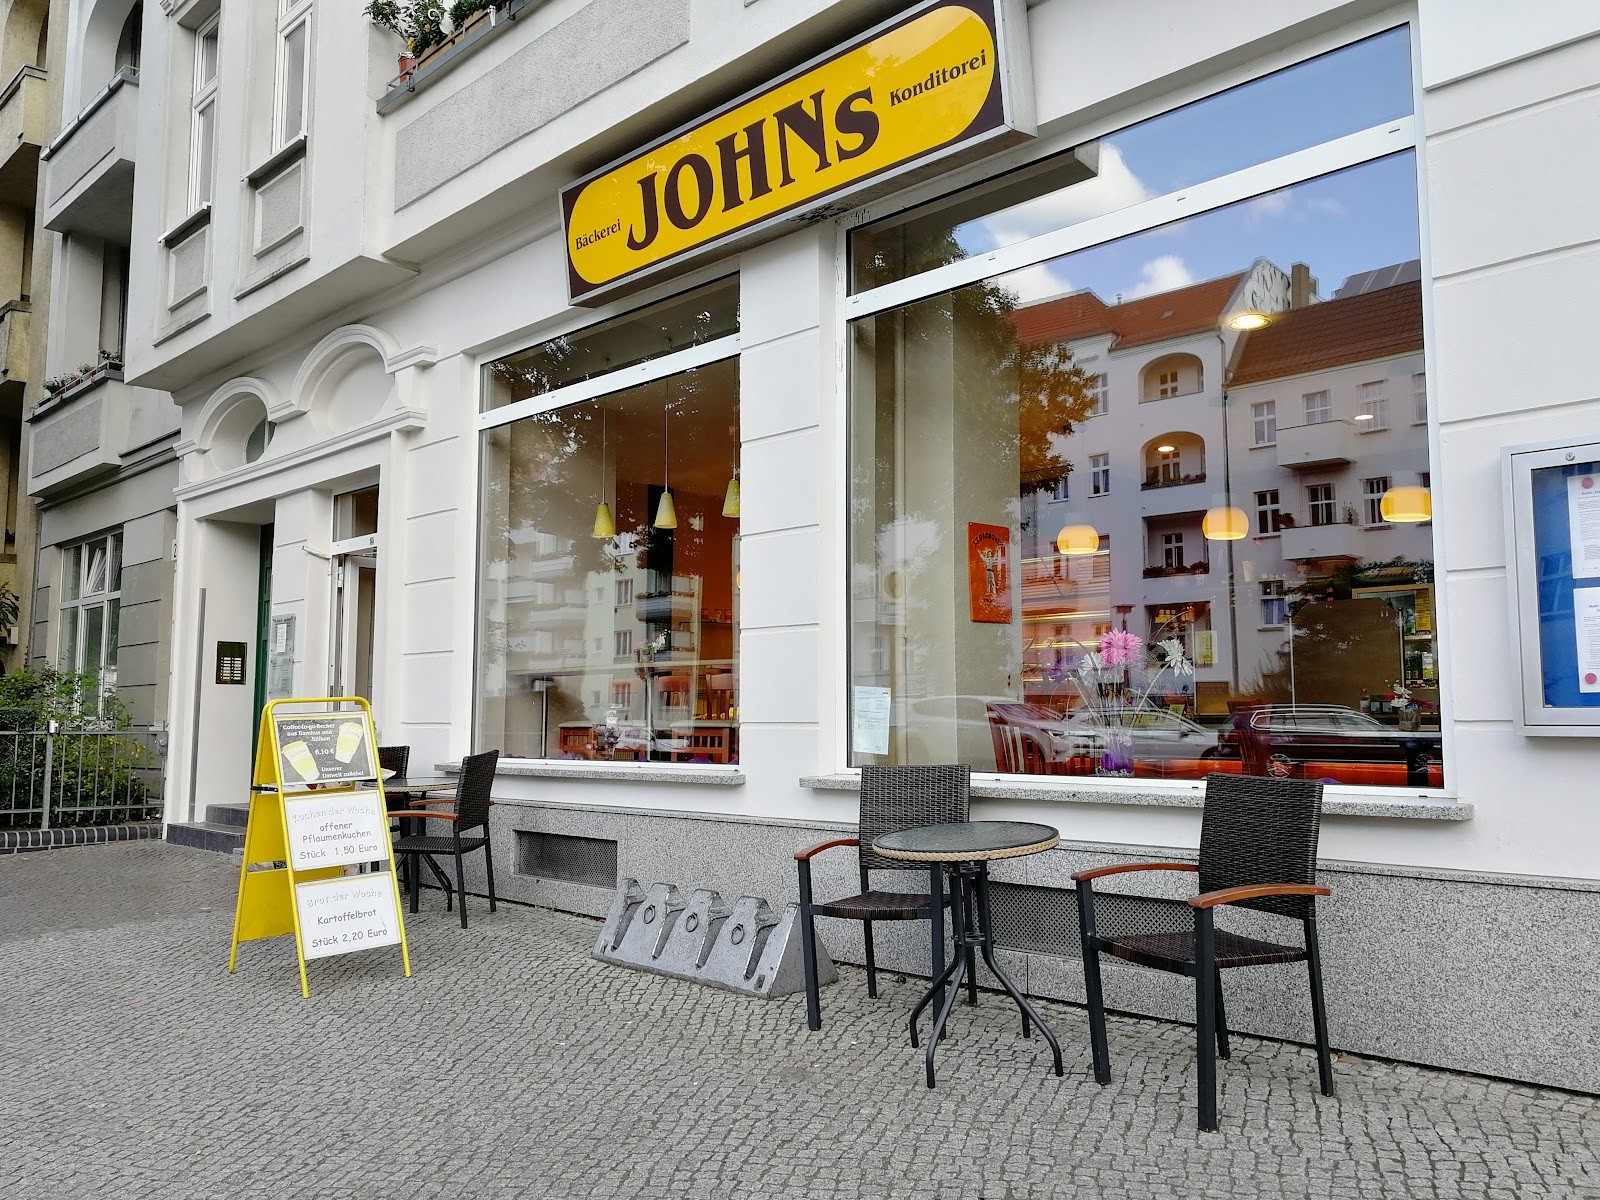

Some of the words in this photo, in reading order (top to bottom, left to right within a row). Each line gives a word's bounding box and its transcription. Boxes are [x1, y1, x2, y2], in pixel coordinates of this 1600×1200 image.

[575, 218, 622, 251] Bäckerei
[626, 87, 881, 251] JOHNS
[889, 49, 988, 107] Konditorei
[319, 822, 353, 832] offener
[302, 829, 372, 844] Pflaumenkuchen
[299, 849, 327, 860] Stück
[334, 845, 355, 857] 1,50
[358, 844, 378, 853] Euro
[332, 892, 350, 902] der
[351, 888, 383, 899] Woche
[317, 908, 377, 926] Kartoffelbrot
[311, 935, 339, 948] Stück
[342, 930, 364, 944] 2,20
[367, 928, 388, 938] Euro
